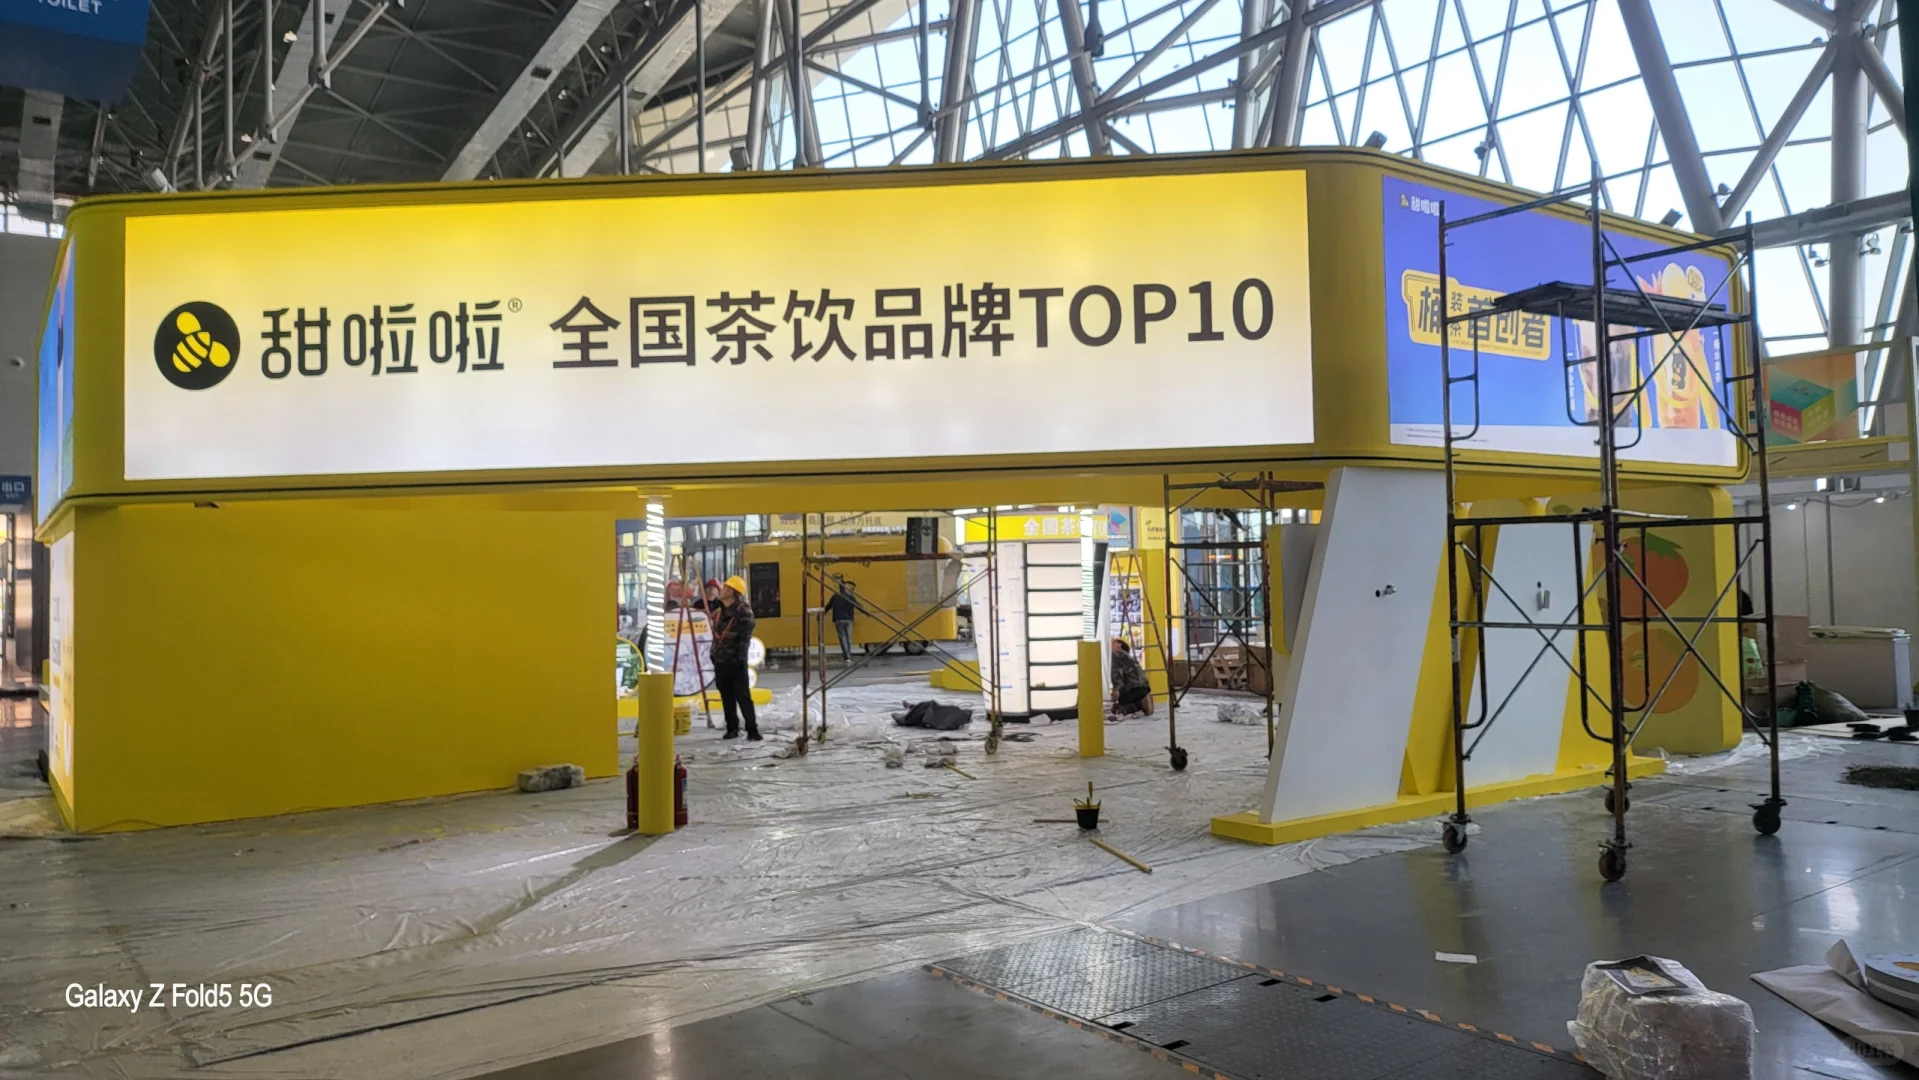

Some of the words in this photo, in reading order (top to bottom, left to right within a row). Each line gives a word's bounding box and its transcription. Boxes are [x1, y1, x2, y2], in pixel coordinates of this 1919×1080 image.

[262, 301, 504, 379] 甜啦啦
[550, 279, 1274, 369] 全国茶饮品牌TOP10
